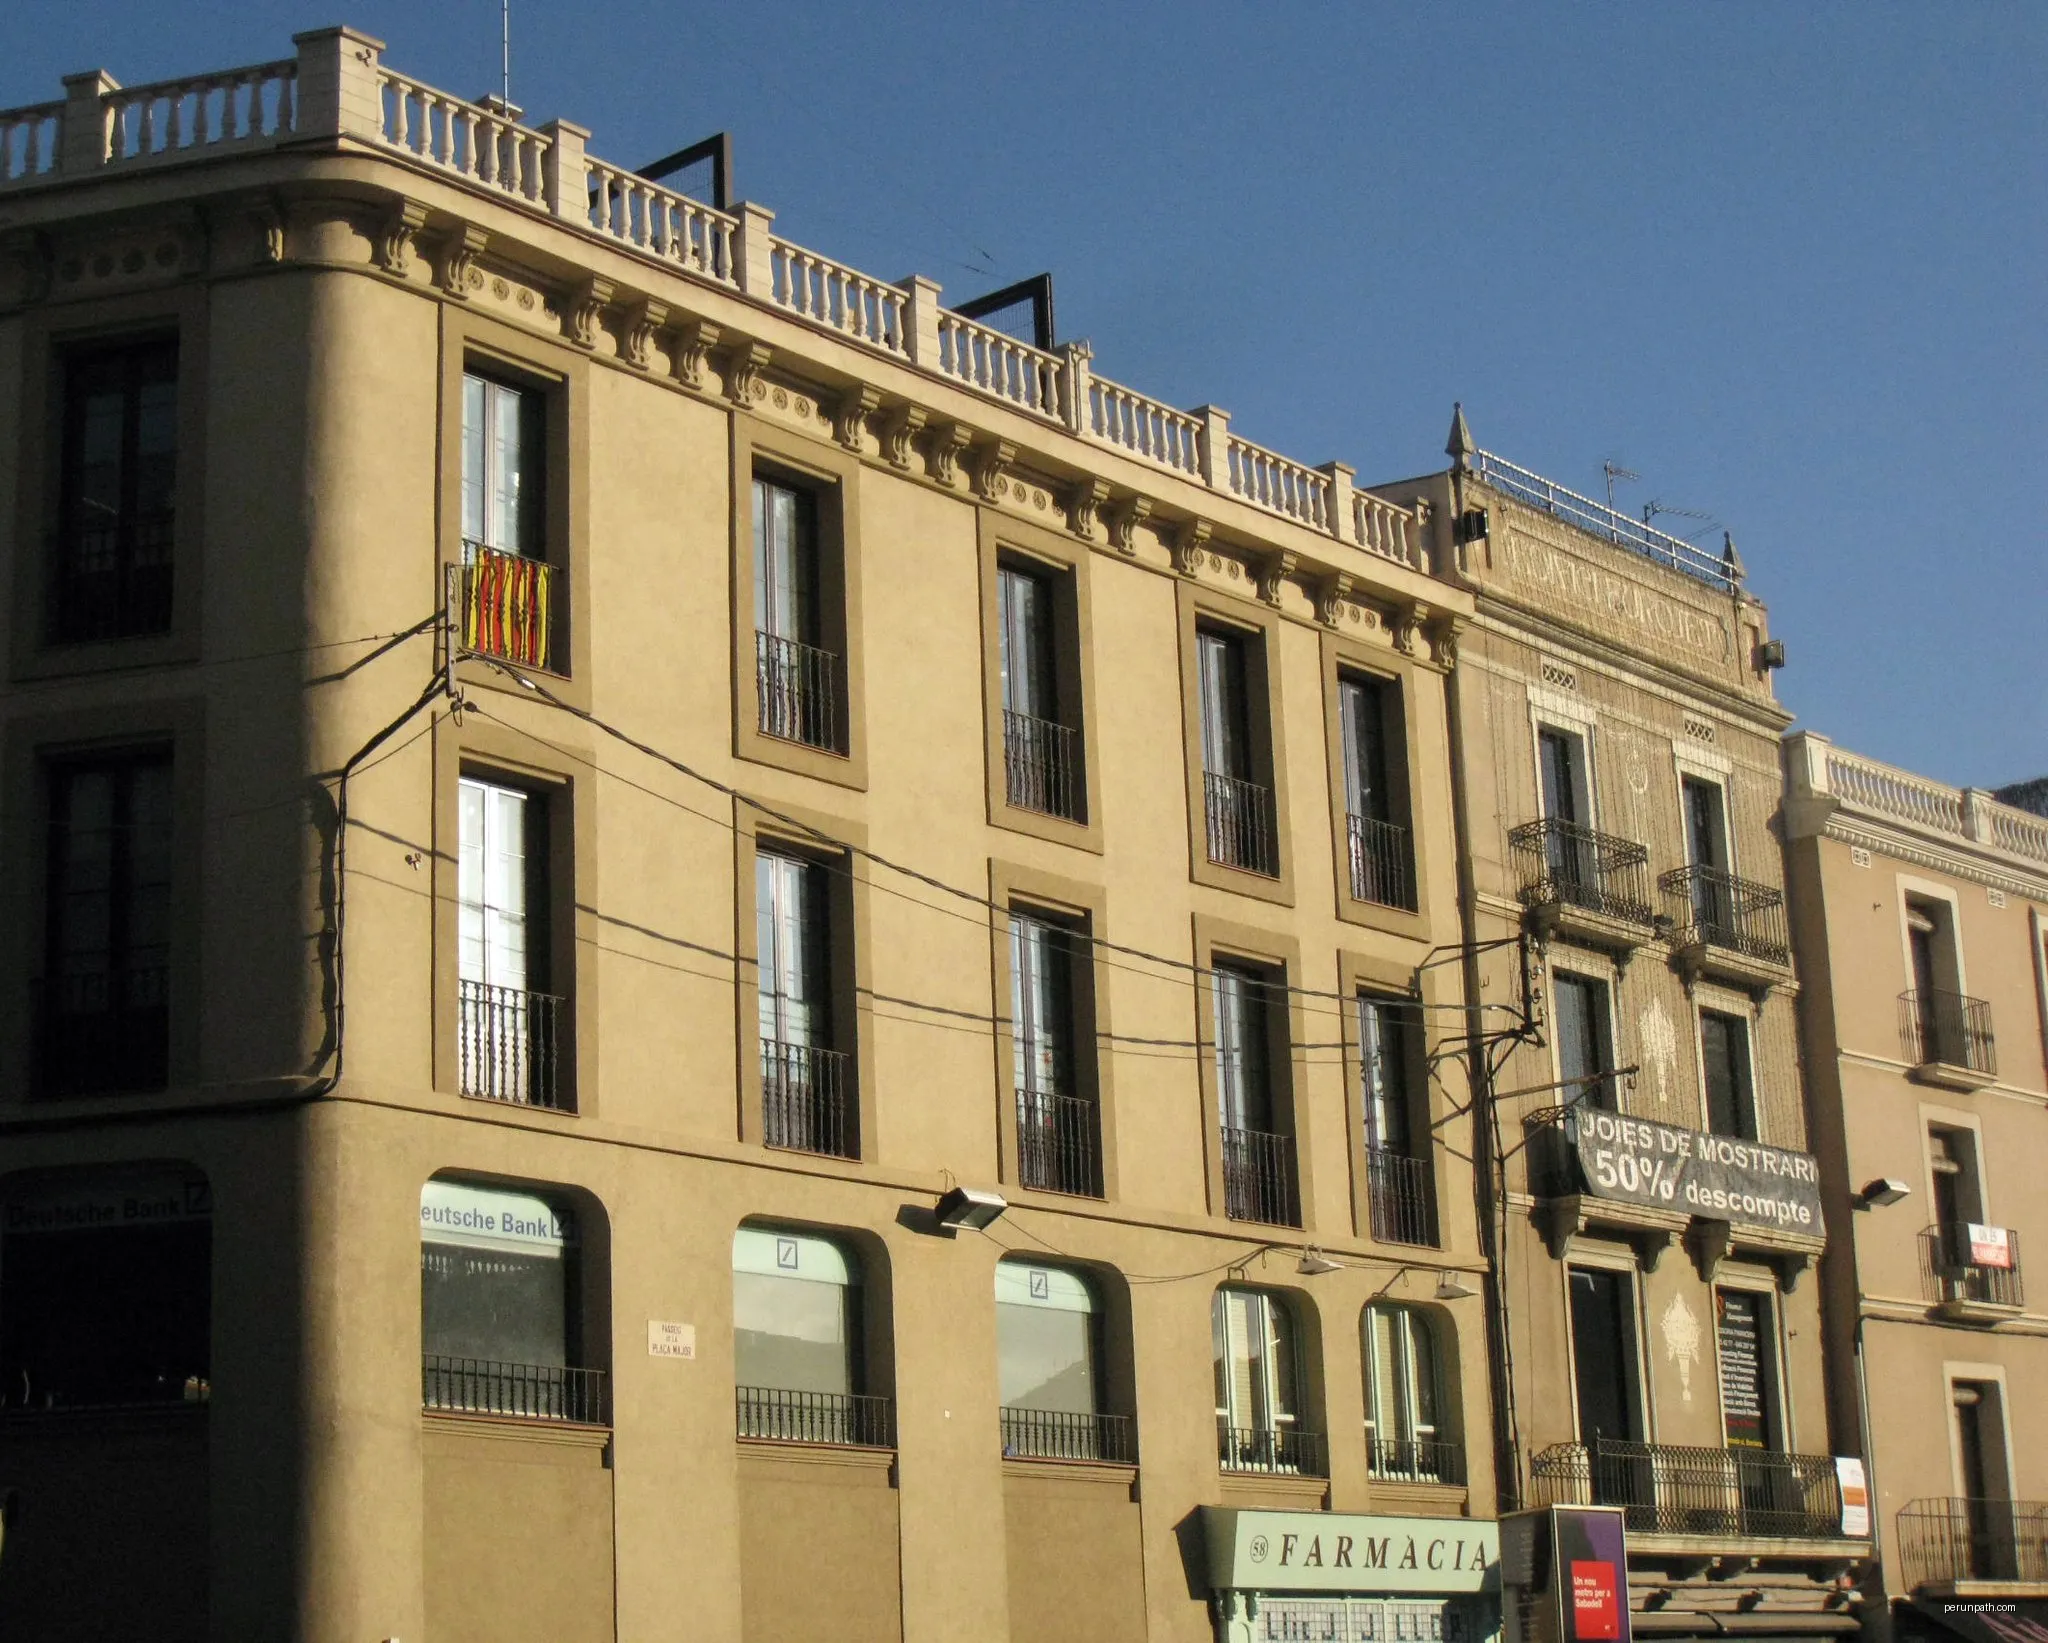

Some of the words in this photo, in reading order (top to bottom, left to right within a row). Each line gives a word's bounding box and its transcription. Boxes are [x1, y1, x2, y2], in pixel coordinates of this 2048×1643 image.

[1582, 1111, 1653, 1150] JOIES
[1660, 1129, 1691, 1158] DE
[1596, 1150, 1674, 1200] 50%
[1686, 1180, 1811, 1225] descompte
[123, 1197, 180, 1219] Bank
[421, 1205, 495, 1230] eutsche
[502, 1212, 547, 1238] Bank
[673, 1344, 691, 1356] MAJOR
[1252, 1539, 1266, 1558] 58
[1279, 1534, 1488, 1572] FARMÀCIA
[1574, 1576, 1583, 1585] Un
[1575, 1589, 1593, 1597] metro
[1595, 1590, 1605, 1599] per
